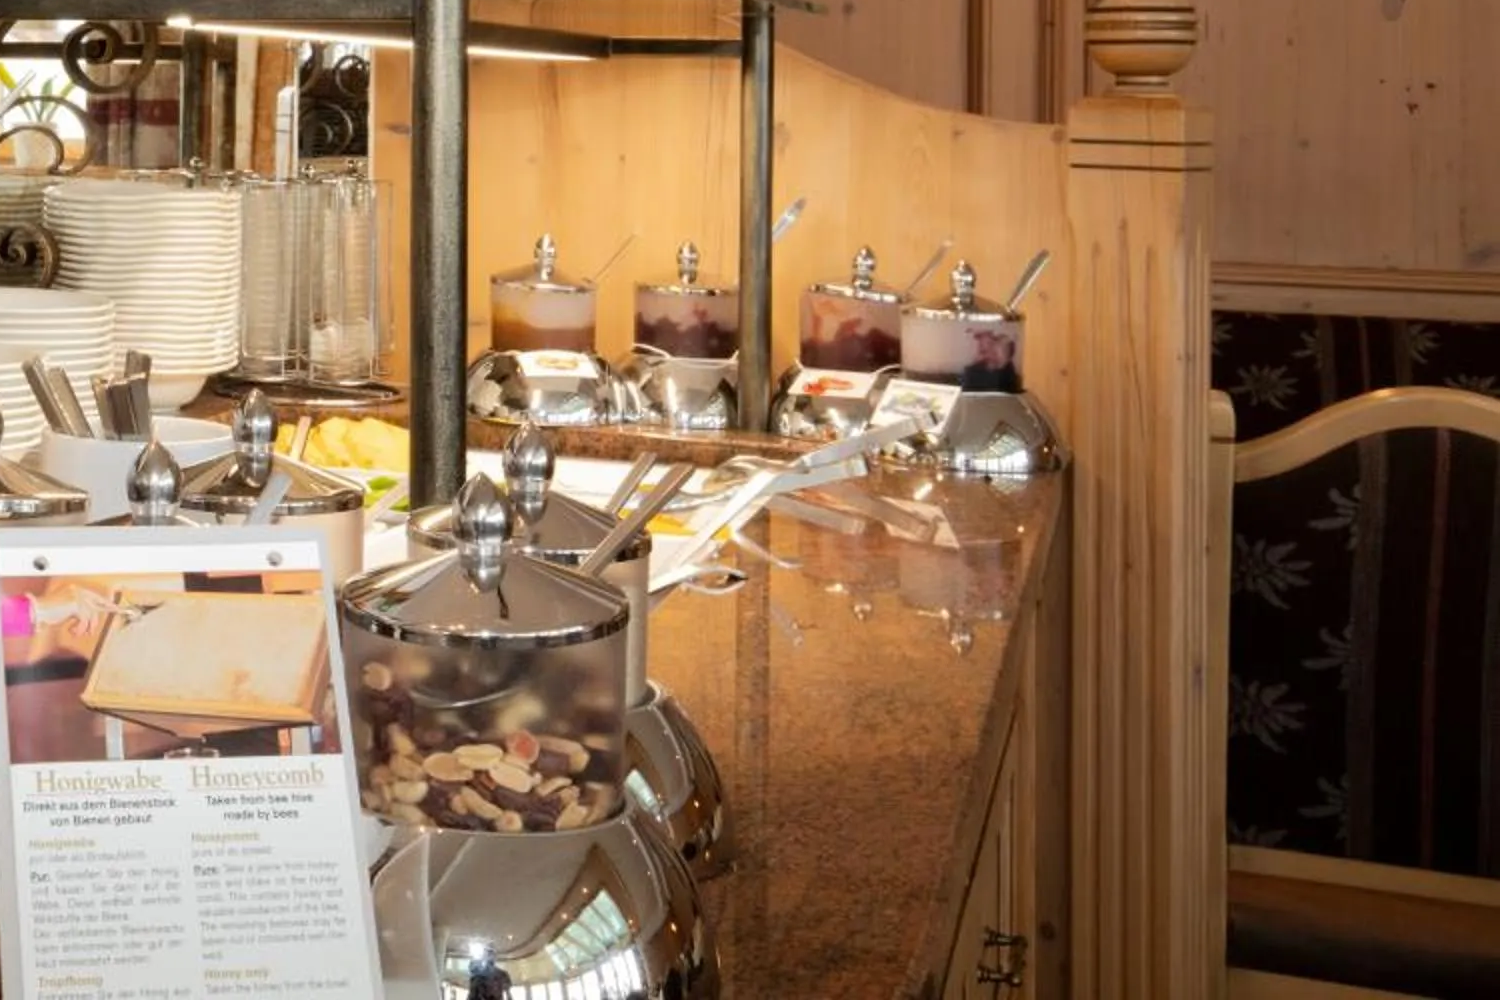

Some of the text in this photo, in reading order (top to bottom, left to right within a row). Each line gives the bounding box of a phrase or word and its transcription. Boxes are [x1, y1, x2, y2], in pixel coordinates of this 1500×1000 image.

[36, 767, 162, 795] Honigwabe
[192, 762, 325, 791] Honeycomb
[23, 797, 177, 812] Direkt aus dem Bienenstock
[205, 794, 238, 806] Taken
[50, 813, 153, 826] von Bienen gebaut
[223, 808, 299, 821] made by bees
